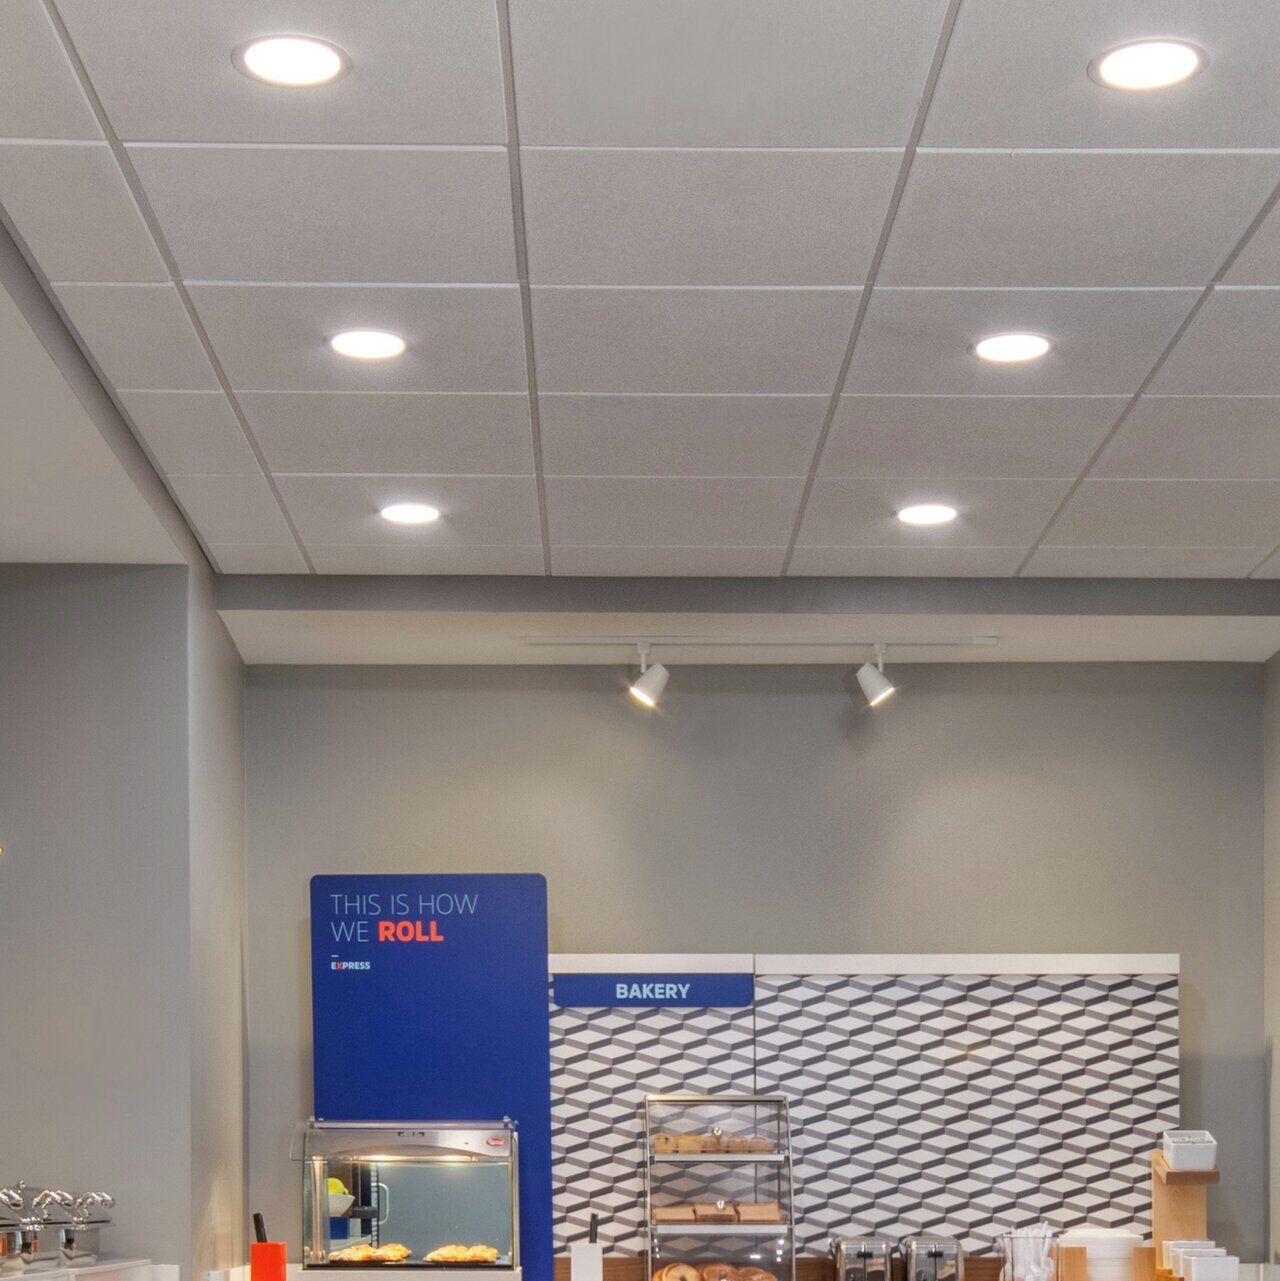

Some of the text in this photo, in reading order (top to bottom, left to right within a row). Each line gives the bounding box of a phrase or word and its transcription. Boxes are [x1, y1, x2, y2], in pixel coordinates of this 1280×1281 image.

[330, 893, 479, 915] THIS IS HOW
[330, 920, 445, 942] WE ROLL
[330, 961, 371, 970] EXPRESS
[615, 983, 691, 1000] BAKERY
